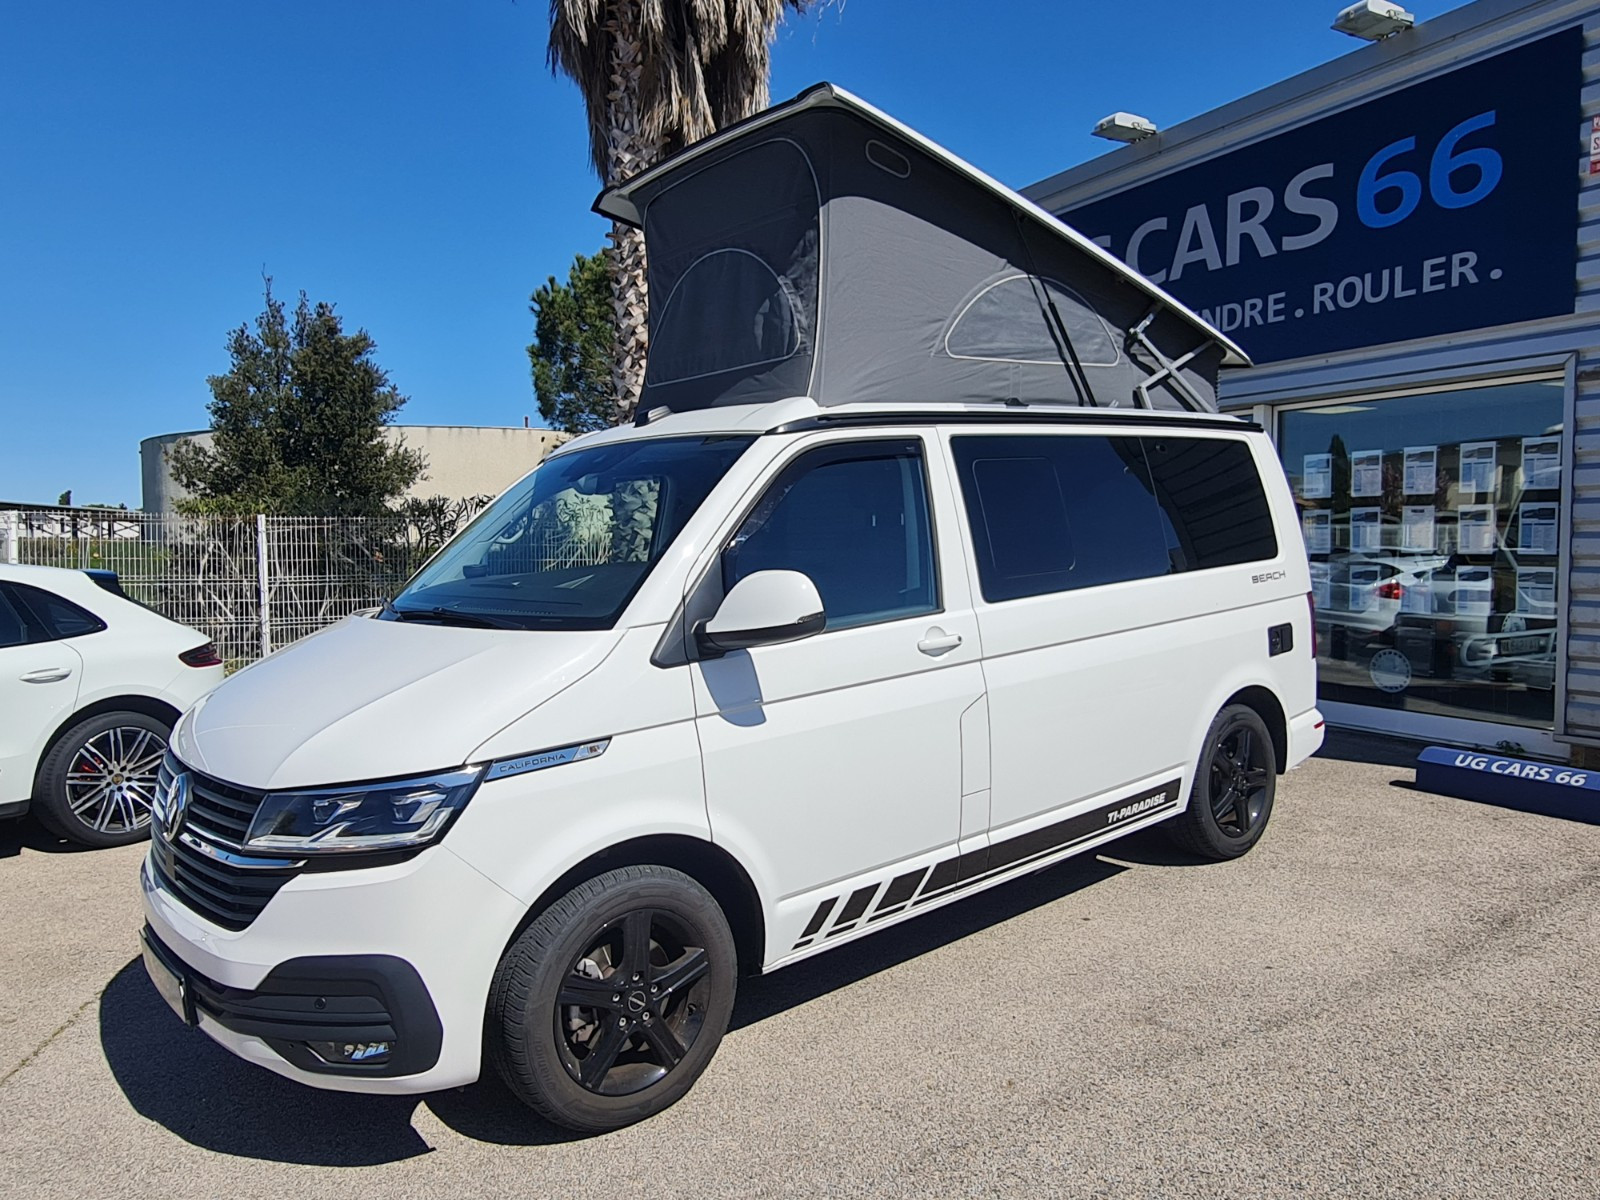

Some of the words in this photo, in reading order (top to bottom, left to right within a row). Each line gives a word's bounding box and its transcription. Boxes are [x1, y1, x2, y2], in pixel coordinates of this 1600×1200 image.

[1125, 163, 1339, 286] CARS
[1356, 110, 1504, 230] 66
[1251, 570, 1286, 584] BEACH
[500, 753, 566, 773] CALIFORNIA
[1454, 754, 1489, 770] UG
[1490, 761, 1553, 780] CARS
[1555, 771, 1587, 786] 66
